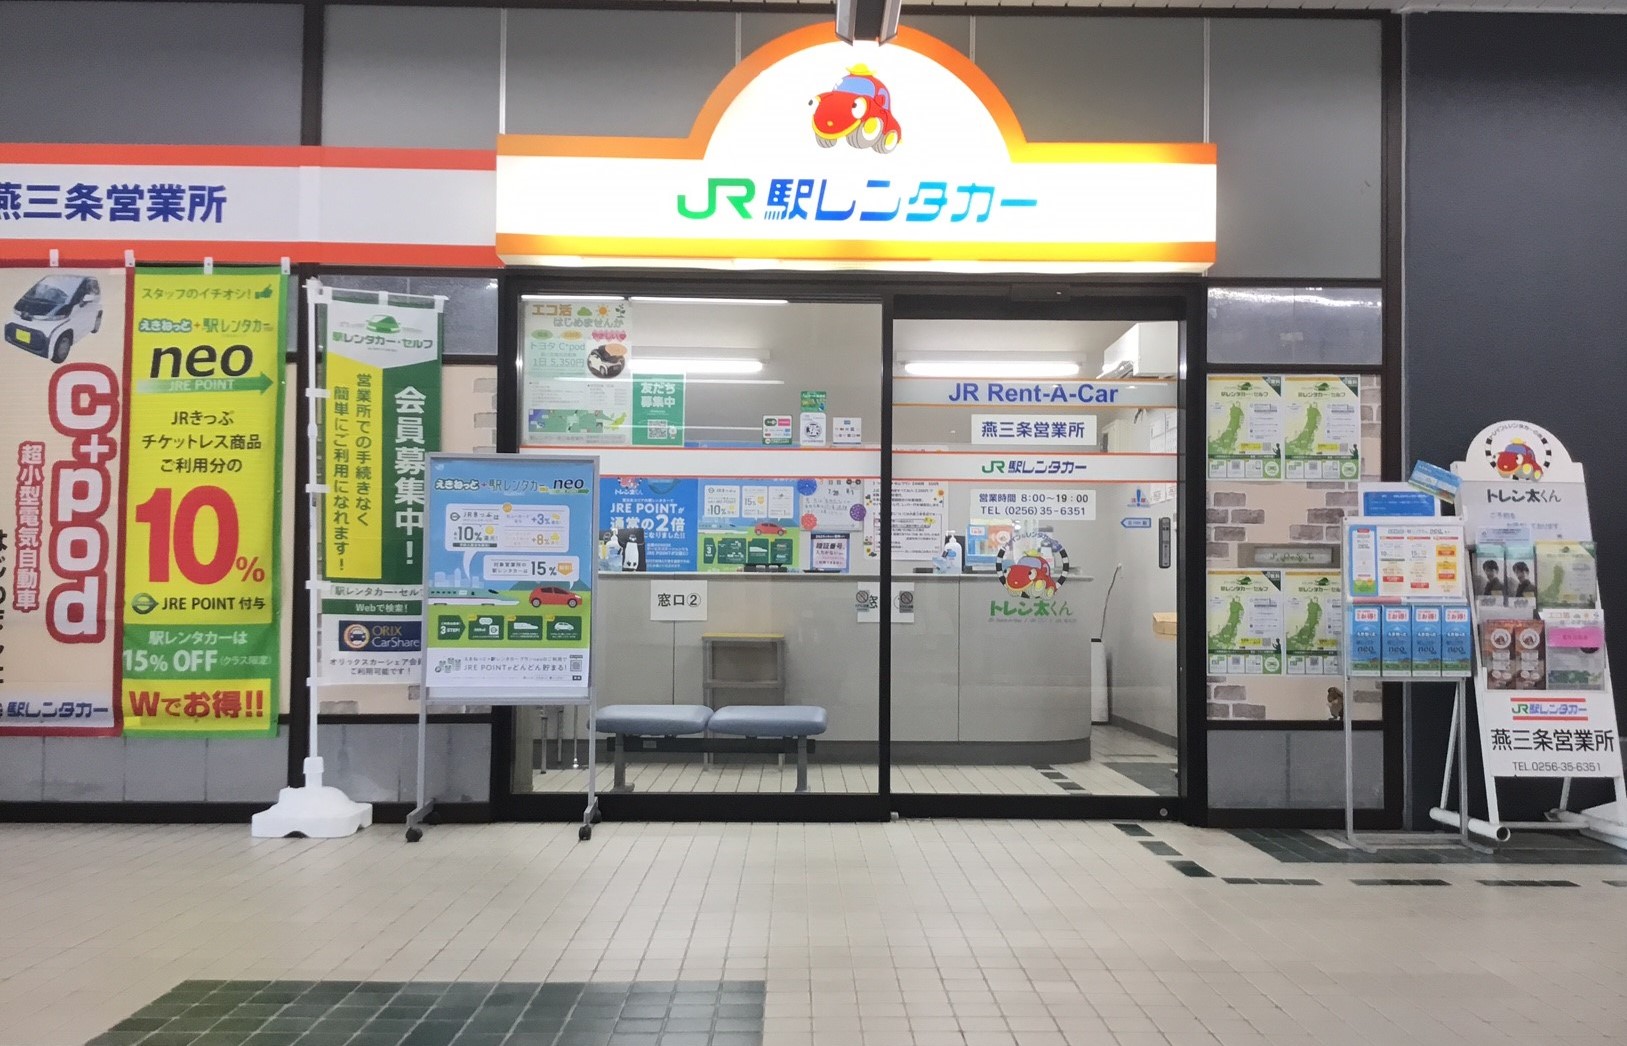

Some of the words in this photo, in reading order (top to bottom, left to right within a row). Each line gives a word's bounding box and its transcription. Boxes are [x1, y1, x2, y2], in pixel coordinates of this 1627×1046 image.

[0, 183, 227, 223] 燕三条営業所
[677, 178, 756, 220] JR
[764, 179, 1038, 222] 駅レンタカー
[150, 344, 254, 379] neo
[168, 379, 190, 392] JRE
[194, 379, 235, 391] POINT
[641, 383, 676, 395] 友だち
[948, 383, 979, 402] JR
[987, 383, 1119, 403] Rent-A-Car
[641, 396, 676, 408] 募集中
[171, 411, 234, 425] JRきっぷ
[981, 421, 1085, 439] 燕三条営業所
[142, 434, 261, 450] チケットレス商品
[355, 373, 372, 527] 営業所での手続きなく
[160, 458, 242, 473] ご利用分の
[982, 461, 1005, 473] JR
[1008, 460, 1087, 474] 駅レンタカー
[553, 478, 585, 490] neo
[979, 493, 1017, 503] 営業時間
[1487, 489, 1562, 503] トレン太くん
[610, 503, 632, 513] JRE
[981, 506, 1001, 516] TEL
[14, 441, 45, 612] 超小型電気自動車
[457, 526, 484, 541] 10%
[135, 485, 265, 585] 10%
[531, 561, 557, 576] 15%
[162, 598, 187, 611] JRE
[191, 597, 235, 611] POINT
[239, 597, 266, 610] 付与
[990, 600, 1073, 616] トレン太くん
[149, 630, 247, 646] 駅レンタカーは
[371, 625, 402, 637] ORIX
[371, 636, 421, 648] CarShare
[123, 649, 168, 672] 15%
[173, 649, 218, 672] OFF
[7, 701, 108, 718] 駅レンタカー
[1511, 704, 1528, 714] JR
[1529, 704, 1587, 715] 駅レンタカー
[1490, 728, 1614, 752] 燕三条営業所
